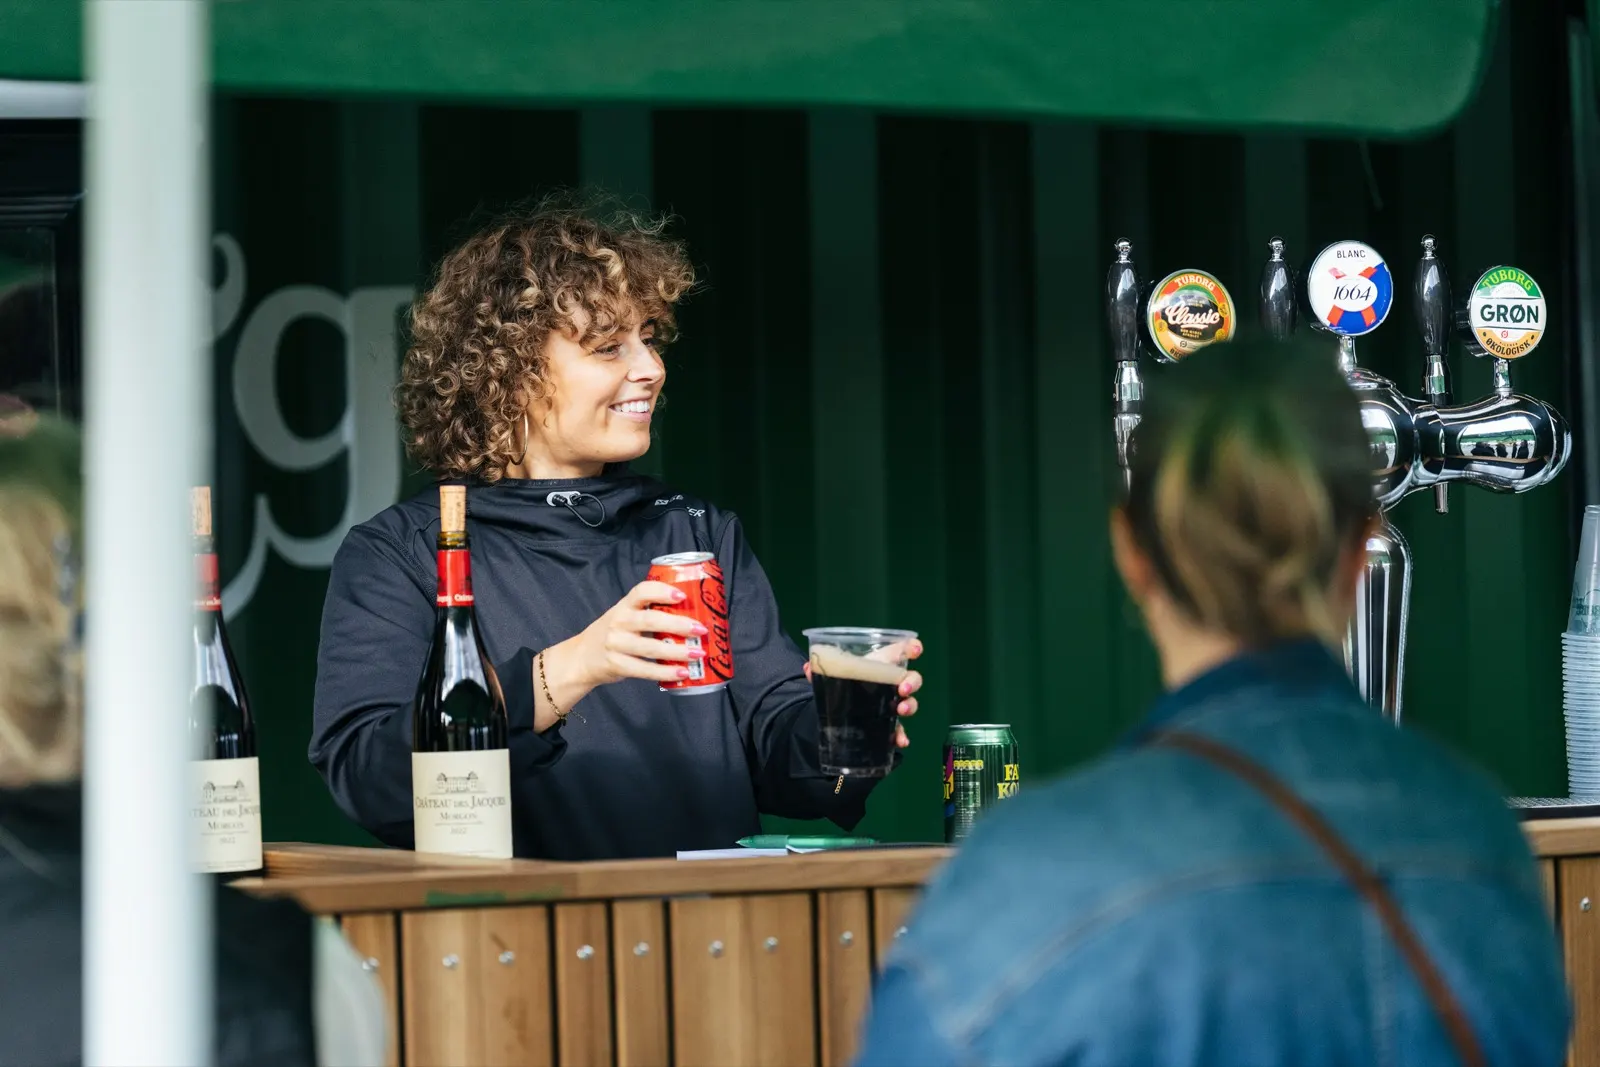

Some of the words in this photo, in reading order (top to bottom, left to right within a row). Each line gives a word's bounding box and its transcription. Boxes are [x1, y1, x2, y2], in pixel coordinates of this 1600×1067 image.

[1336, 249, 1366, 259] BLANC
[1174, 275, 1216, 291] TUBORG
[1482, 269, 1533, 291] TUBORG
[1333, 283, 1372, 301] 1664
[1164, 300, 1220, 325] Classic
[1480, 304, 1539, 323] GRØN
[1485, 337, 1531, 356] ØKOLOGISK
